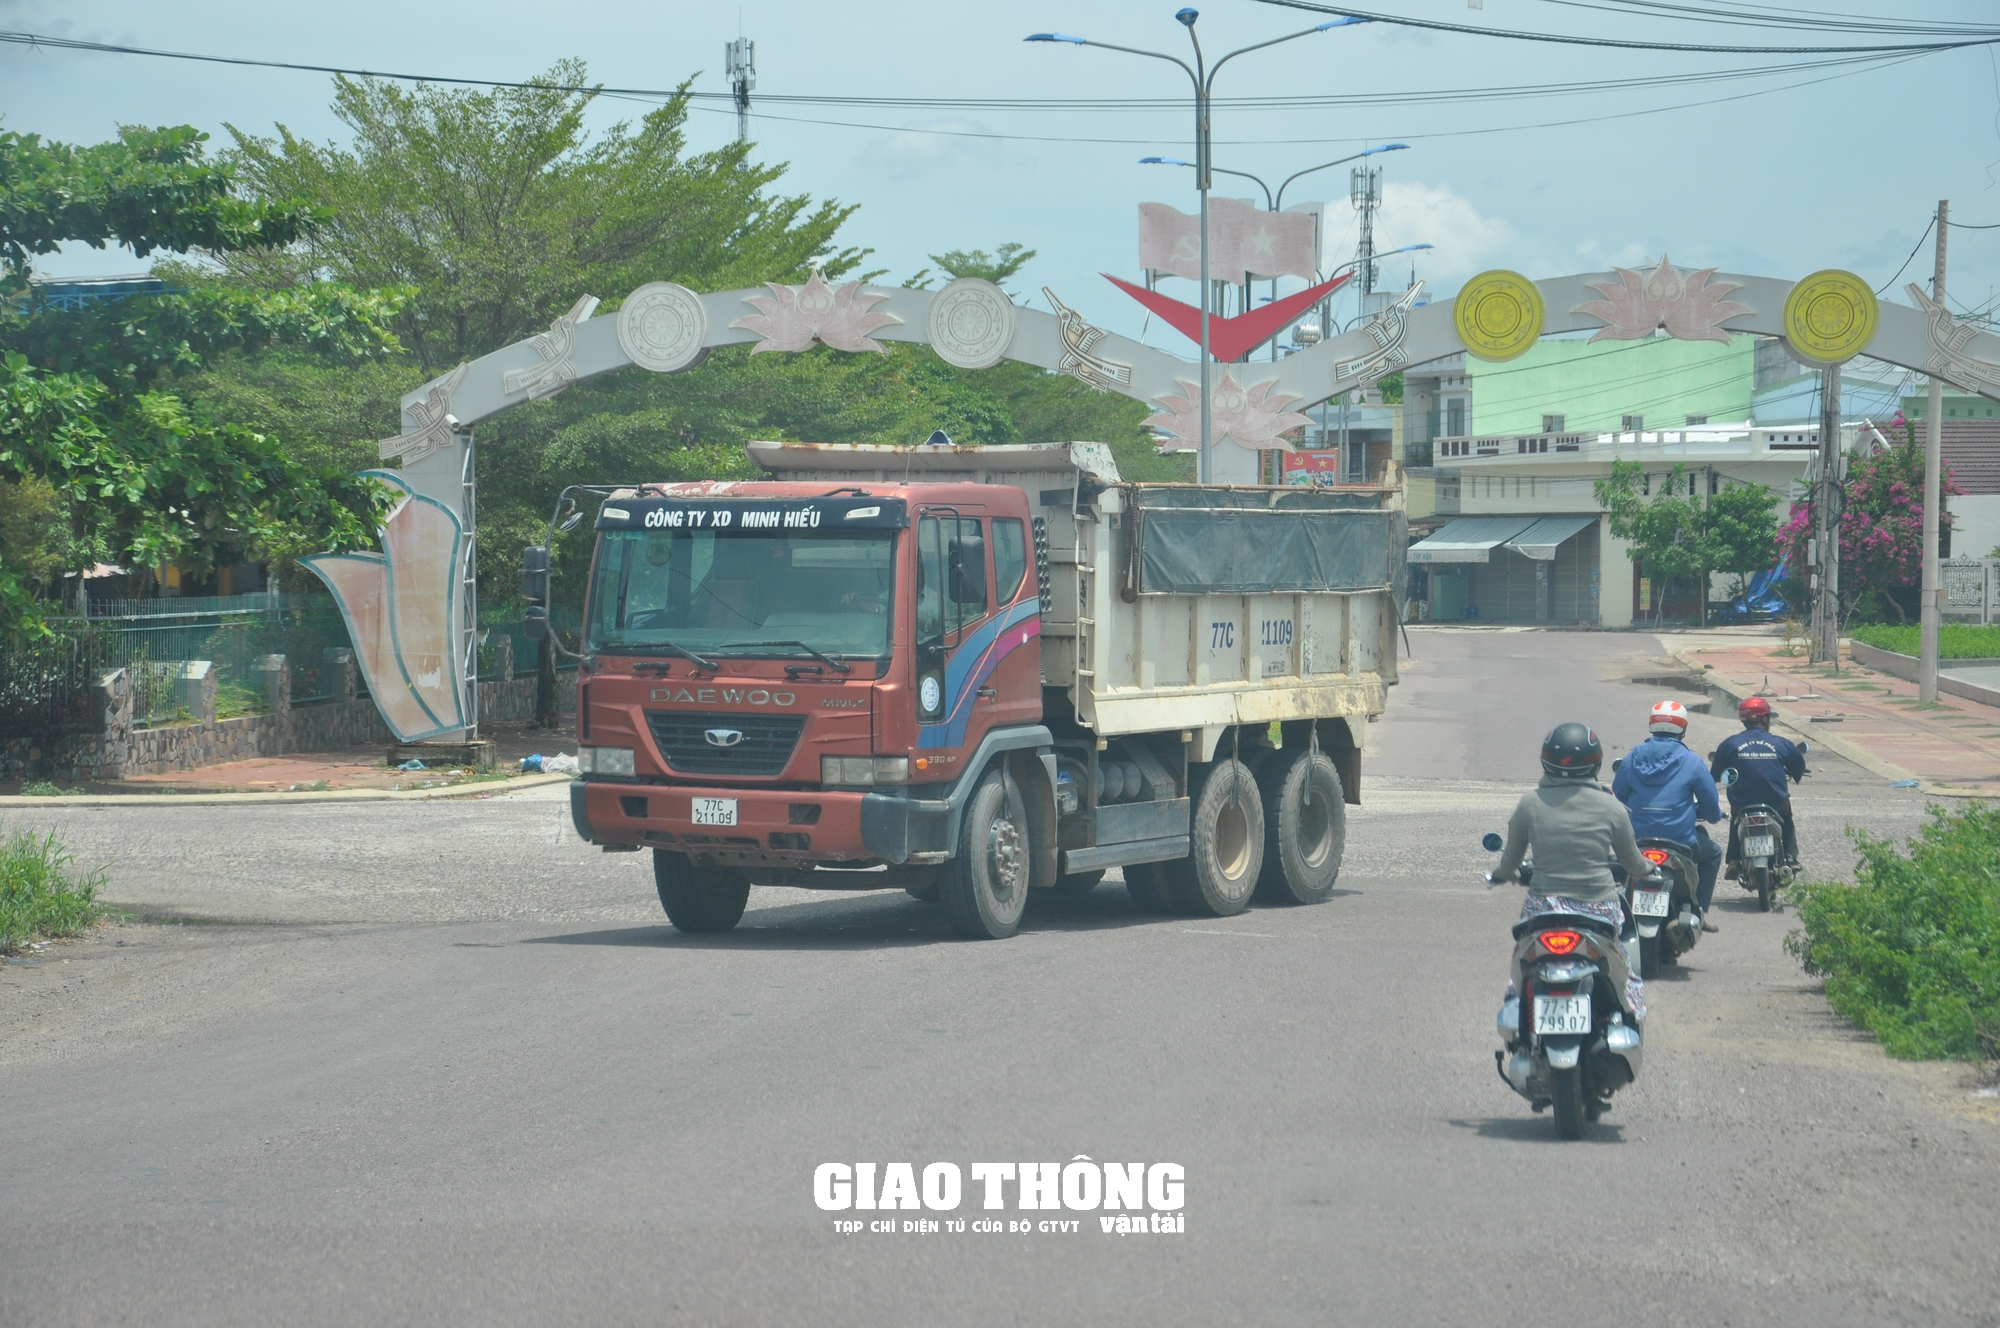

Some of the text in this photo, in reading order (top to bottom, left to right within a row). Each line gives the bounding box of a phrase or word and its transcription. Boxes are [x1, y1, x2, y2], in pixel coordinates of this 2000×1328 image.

[644, 505, 821, 528] CÔNG TY XD MINH HIẾU
[1211, 621, 1234, 648] 77C
[650, 687, 796, 706] DAEWOO
[928, 756, 946, 764] 390
[704, 799, 724, 811] 77C
[696, 812, 732, 824] 211.09
[1539, 1015, 1587, 1031] 799.07
